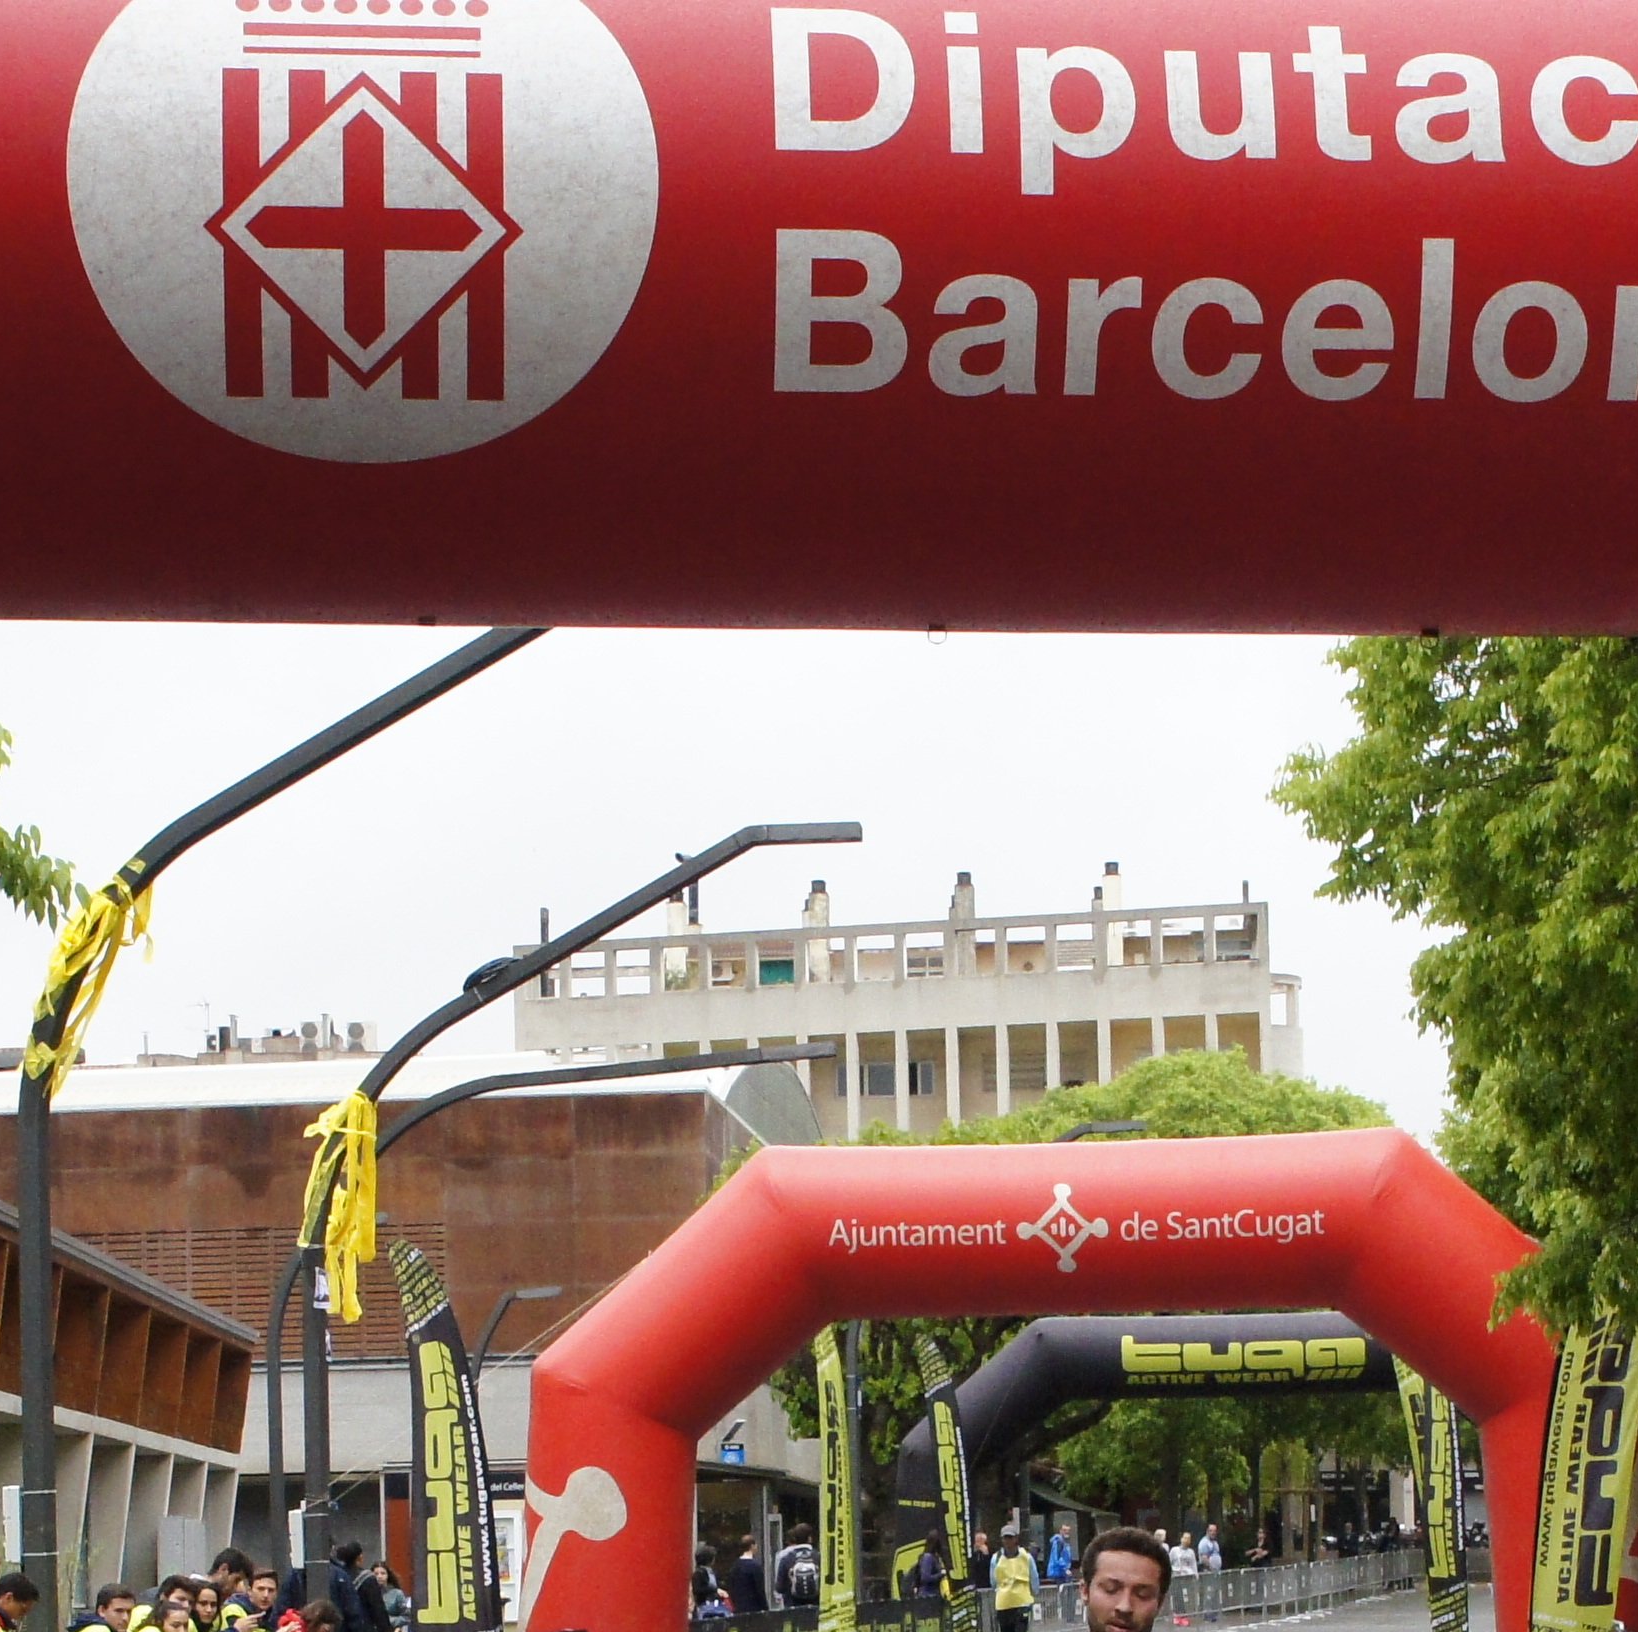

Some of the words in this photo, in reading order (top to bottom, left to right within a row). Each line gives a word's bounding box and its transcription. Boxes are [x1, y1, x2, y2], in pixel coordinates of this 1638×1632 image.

[829, 1216, 1006, 1253] Ajuntament
[1120, 1217, 1158, 1241] de
[1166, 1208, 1324, 1244] SantCugat
[1127, 1373, 1206, 1384] ACTIVE
[1216, 1371, 1290, 1383] WEAR
[452, 1425, 471, 1515] WEAR
[457, 1525, 477, 1622] ACTIVE
